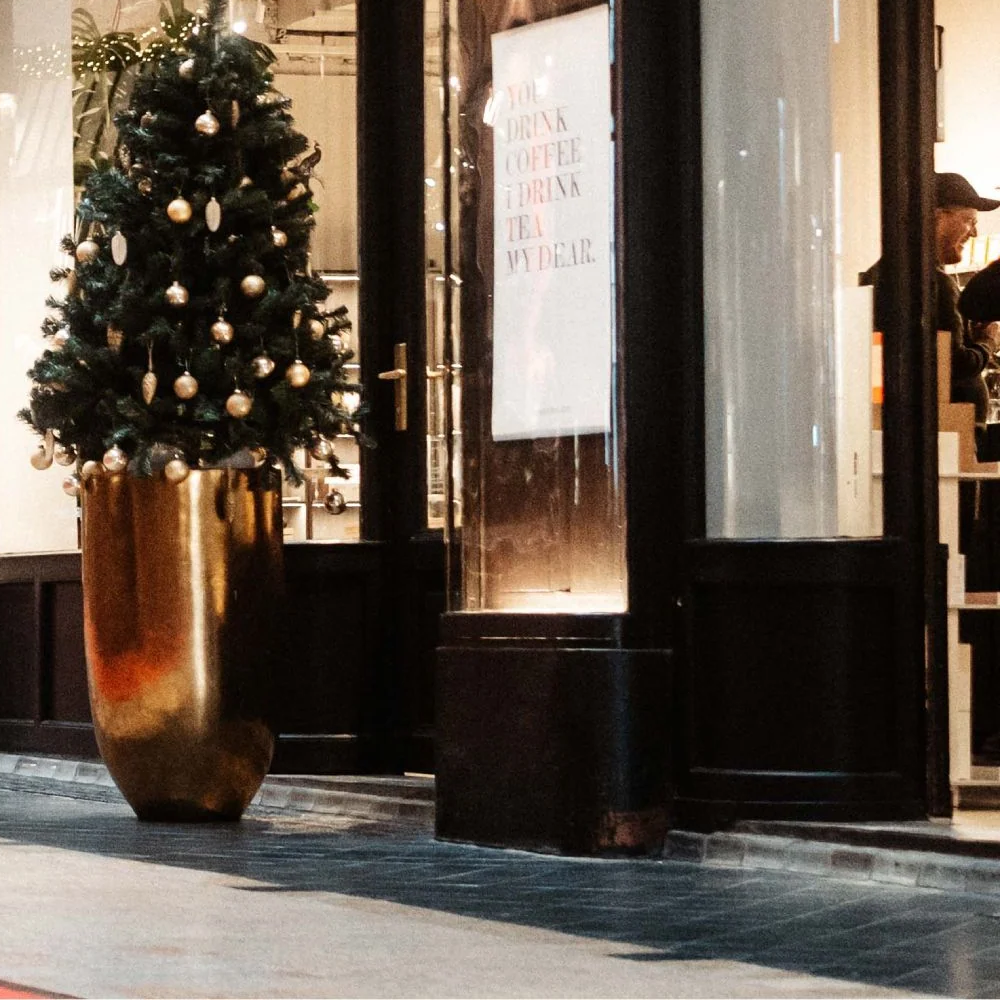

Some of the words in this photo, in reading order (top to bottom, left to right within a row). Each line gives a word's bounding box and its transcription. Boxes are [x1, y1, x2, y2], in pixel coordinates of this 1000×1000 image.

[507, 79, 541, 110] YOU
[507, 106, 569, 144] DRINK
[505, 137, 582, 176] COFFEE
[507, 185, 513, 210] I
[519, 171, 582, 208] DRINK
[506, 213, 544, 243] TEA
[505, 247, 534, 276] MY
[538, 237, 596, 271] DEAR.
